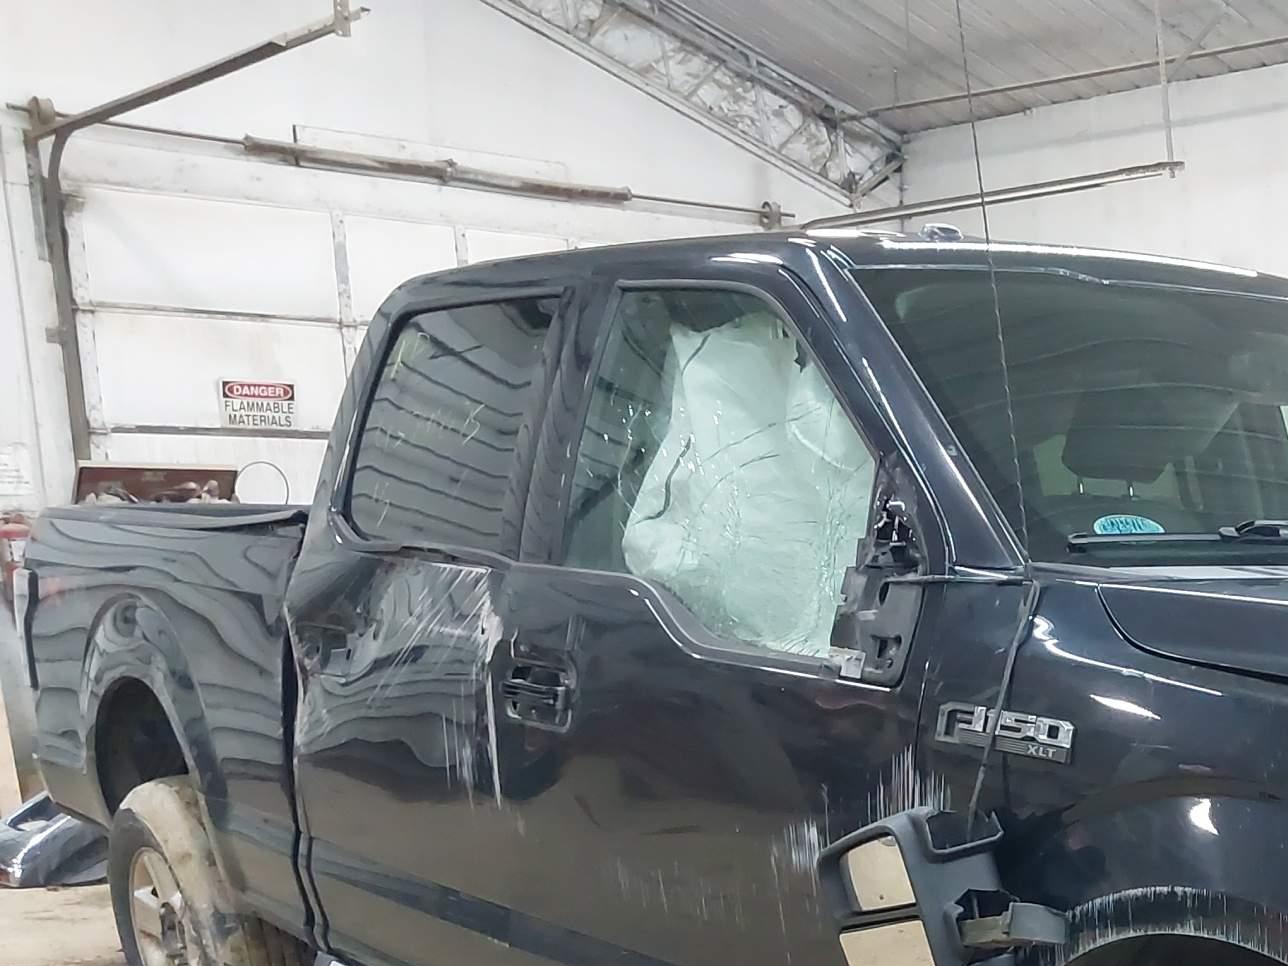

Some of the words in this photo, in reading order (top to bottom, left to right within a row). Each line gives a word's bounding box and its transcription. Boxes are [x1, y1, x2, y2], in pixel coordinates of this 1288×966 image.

[233, 385, 284, 397] DANGER
[225, 400, 294, 414] FLAMMABLE
[228, 414, 292, 427] MATERIALS
[1027, 744, 1057, 758] XLT
